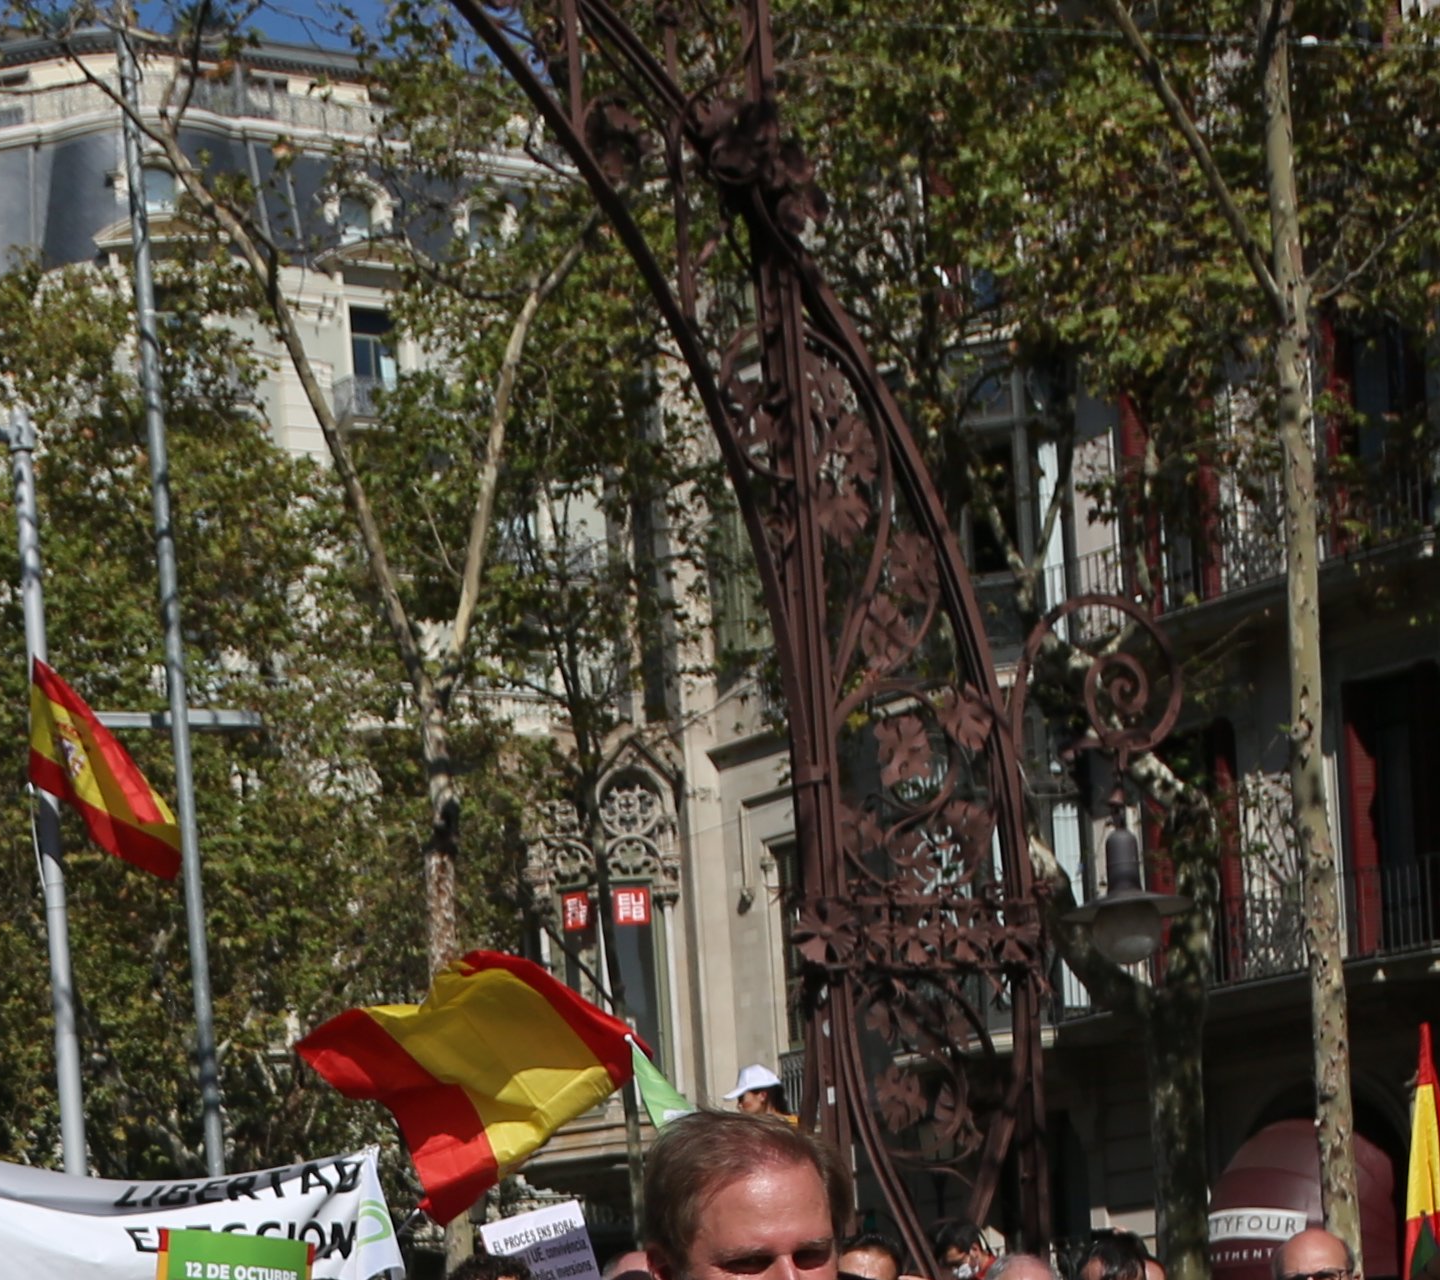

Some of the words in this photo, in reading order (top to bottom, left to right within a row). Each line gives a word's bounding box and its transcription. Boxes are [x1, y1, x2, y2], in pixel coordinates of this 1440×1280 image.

[113, 1160, 363, 1208] LIBERTAD
[492, 1240, 504, 1254] EL
[535, 1223, 553, 1242] ENS
[185, 1261, 201, 1277] 12
[206, 1262, 229, 1279] DE
